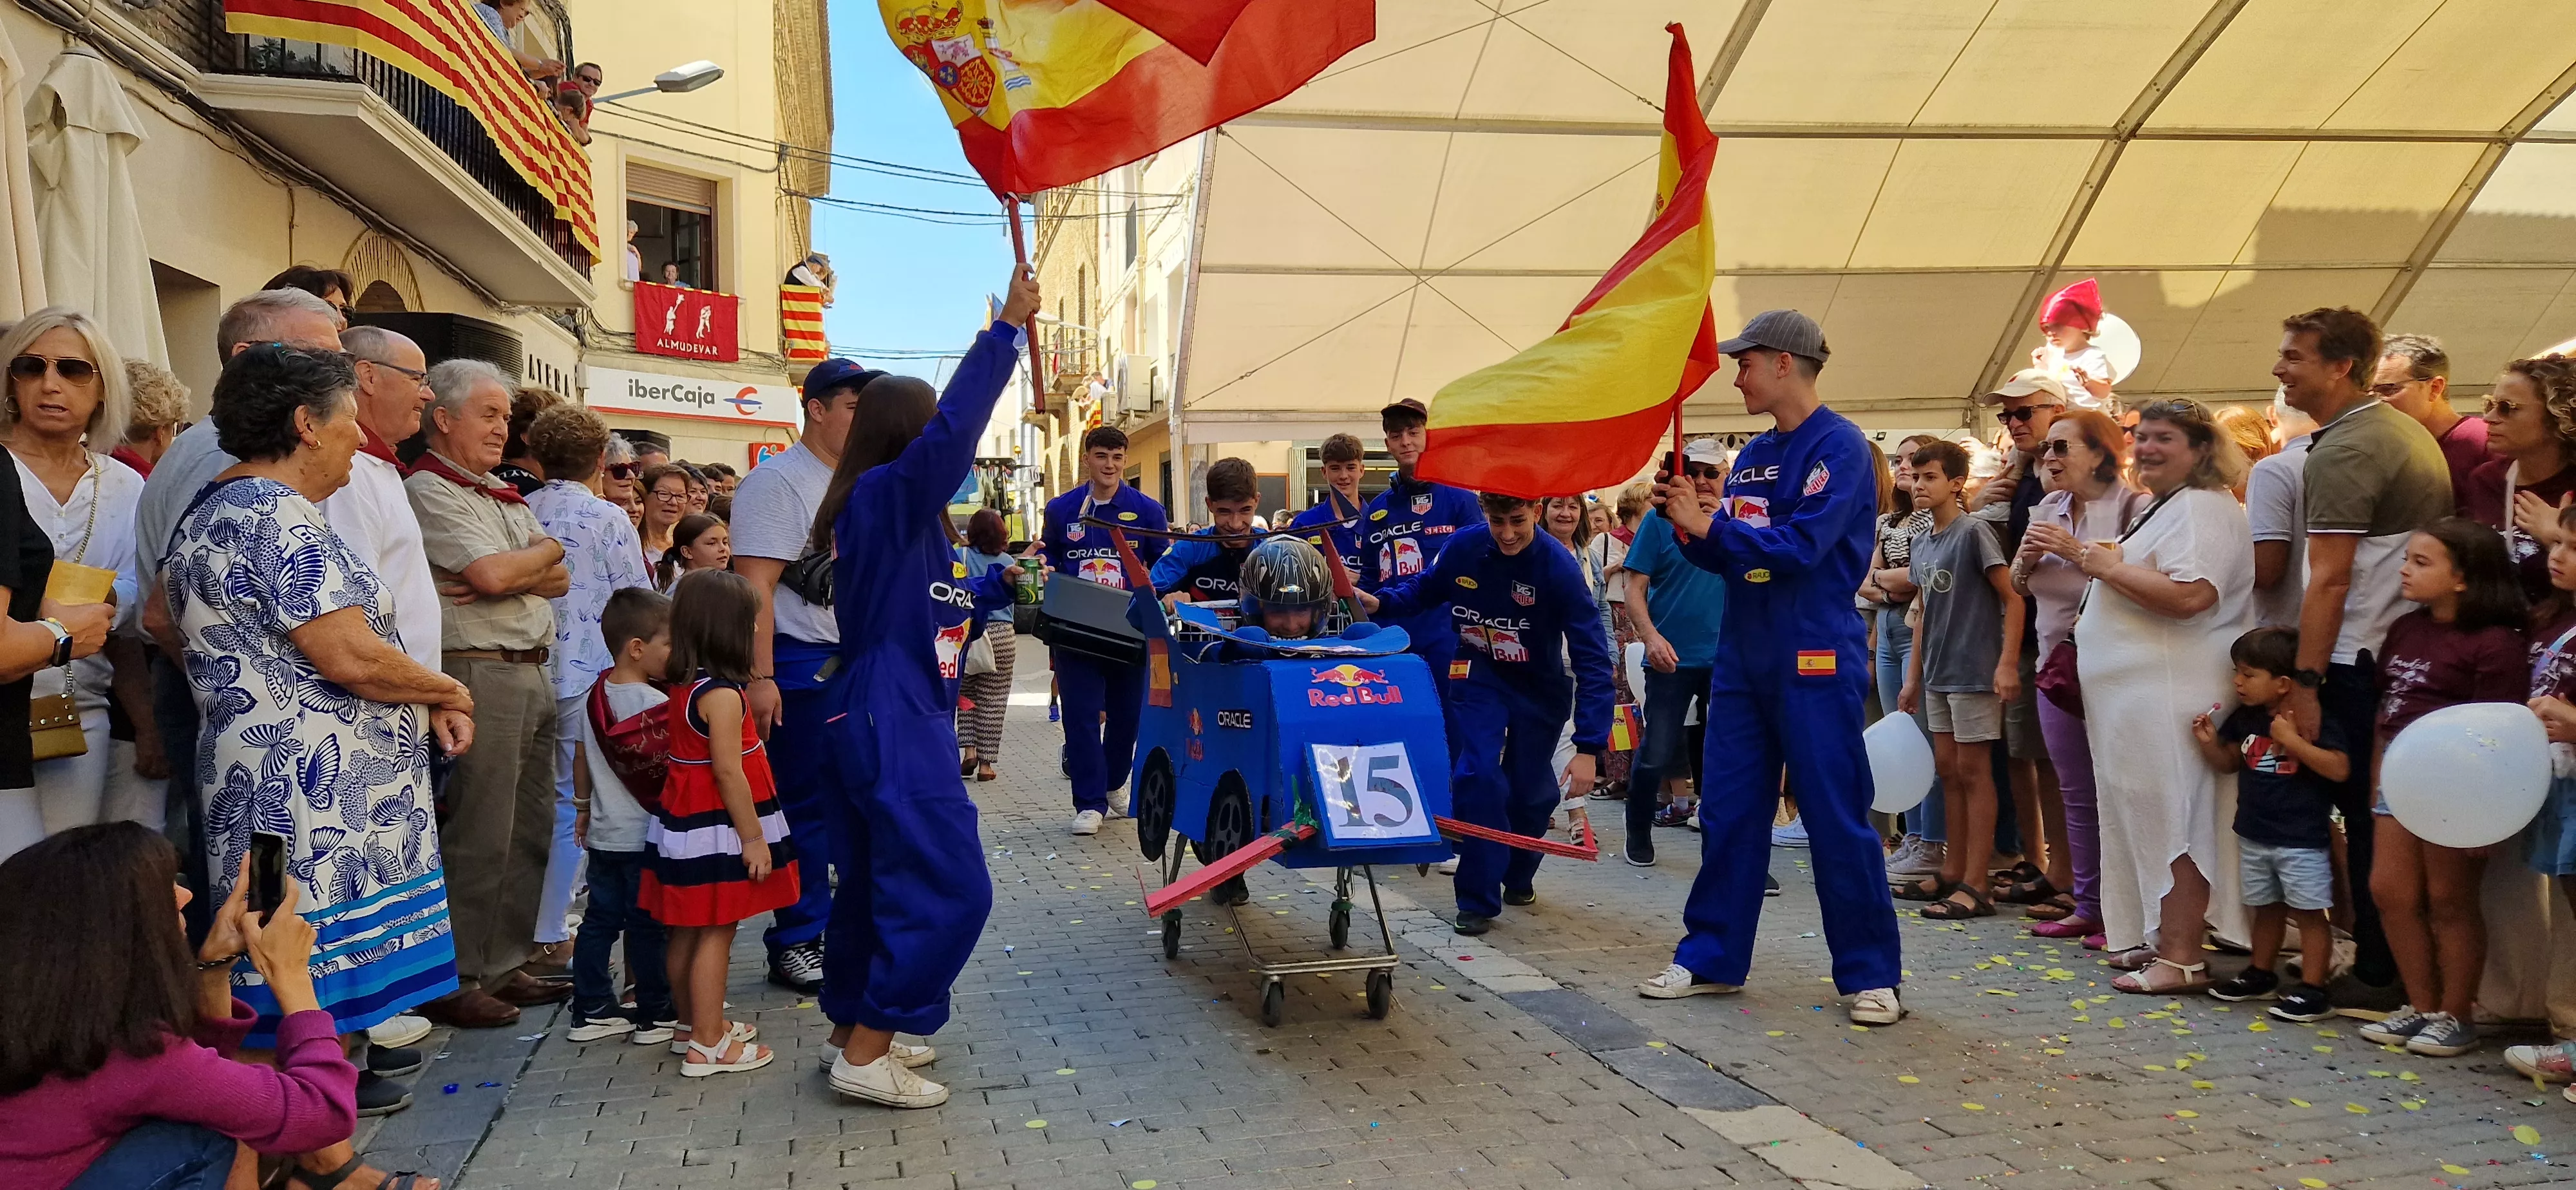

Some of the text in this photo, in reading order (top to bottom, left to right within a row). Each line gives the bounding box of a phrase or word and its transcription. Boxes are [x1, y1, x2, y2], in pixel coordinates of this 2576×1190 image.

[657, 337, 718, 355] ALMUDEVAR
[628, 379, 715, 409] iberCaja
[1804, 470, 1828, 495] HEUER
[1415, 496, 1429, 505] TAG
[1370, 520, 1421, 543] ORACLE
[1399, 558, 1423, 576] Bull
[1515, 584, 1531, 596] TAG
[1452, 605, 1531, 630] ORACLE
[1495, 648, 1530, 661] Bull
[1307, 685, 1403, 707] Red Bull
[1218, 711, 1251, 728] ORACLE
[1338, 755, 1413, 827] 15
